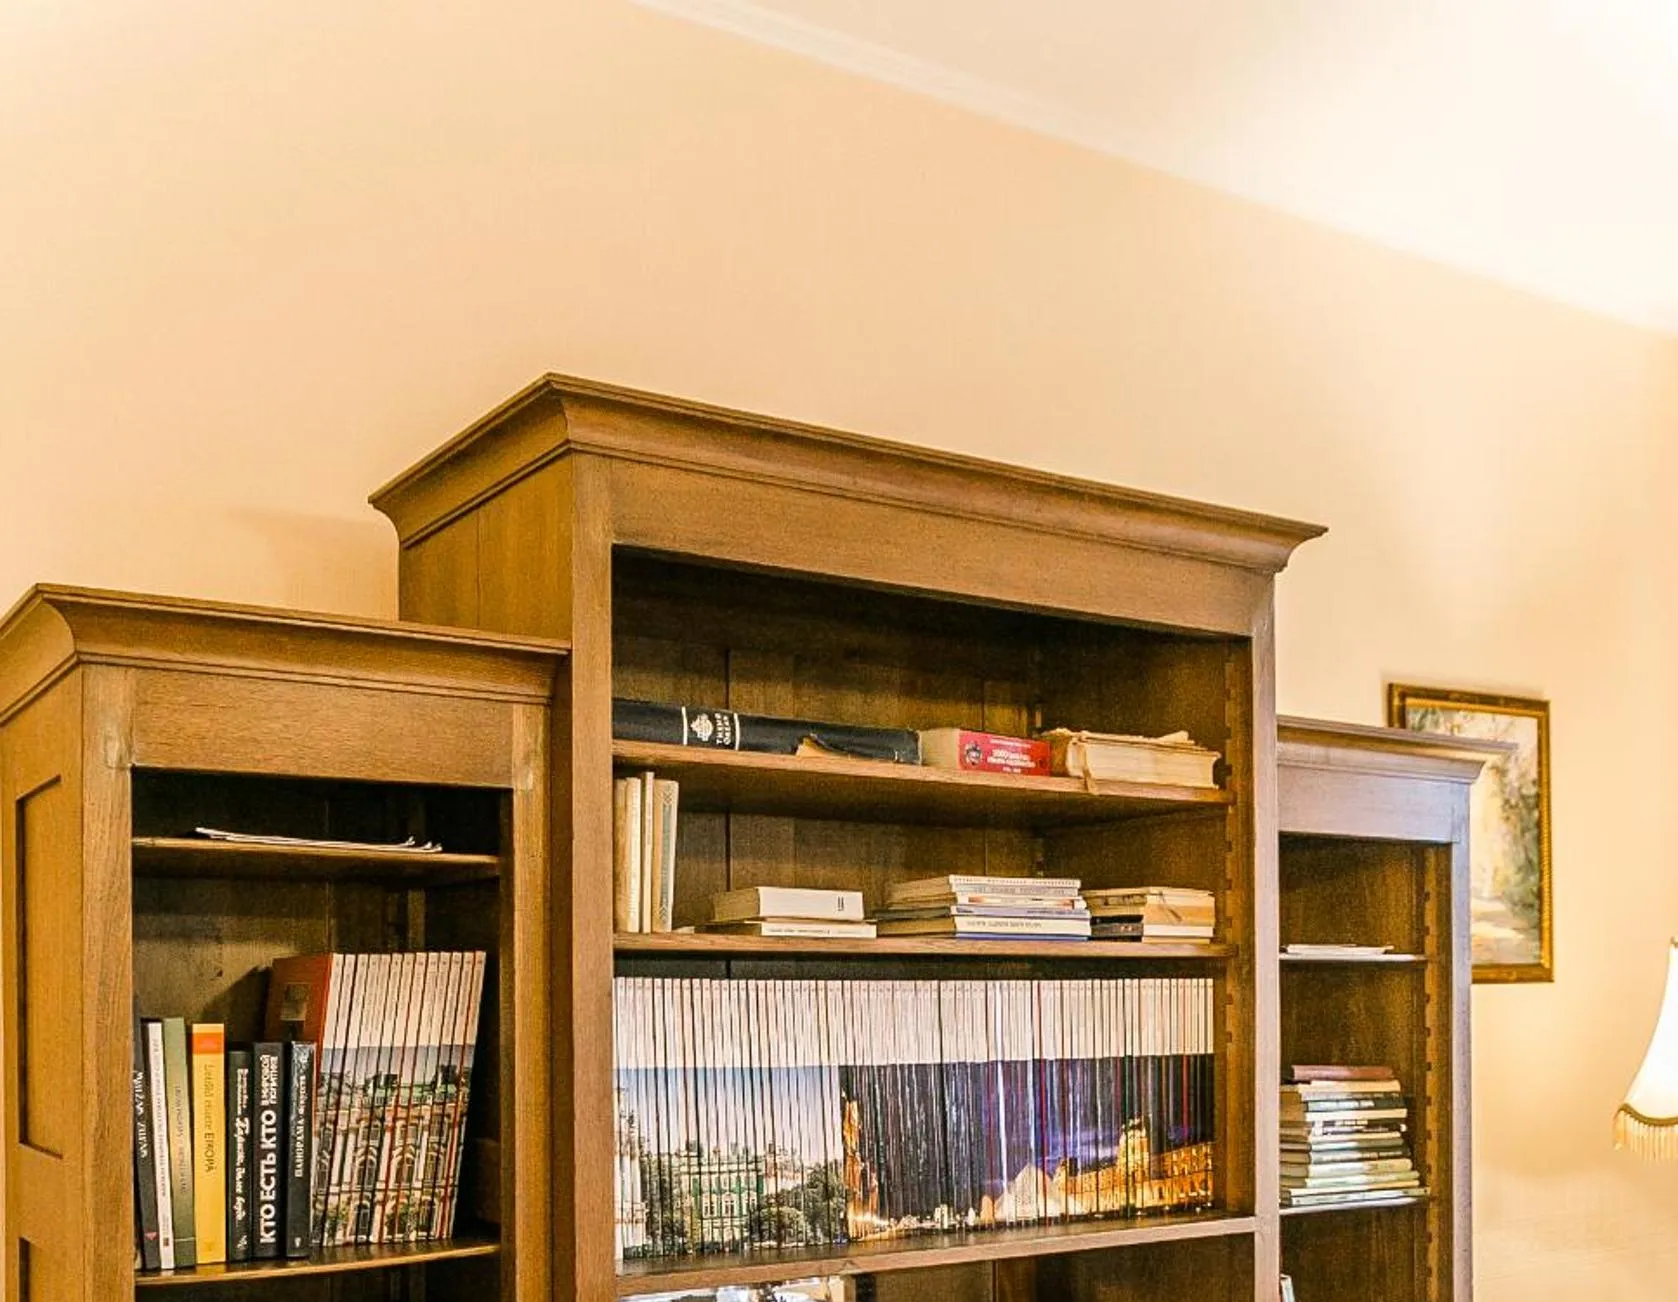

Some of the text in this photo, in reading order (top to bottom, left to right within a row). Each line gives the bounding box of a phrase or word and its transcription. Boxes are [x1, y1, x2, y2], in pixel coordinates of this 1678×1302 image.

[260, 1110, 277, 1243] КТО ЕСТЬ КТО
[294, 1119, 304, 1177] ПАНОРАМА
